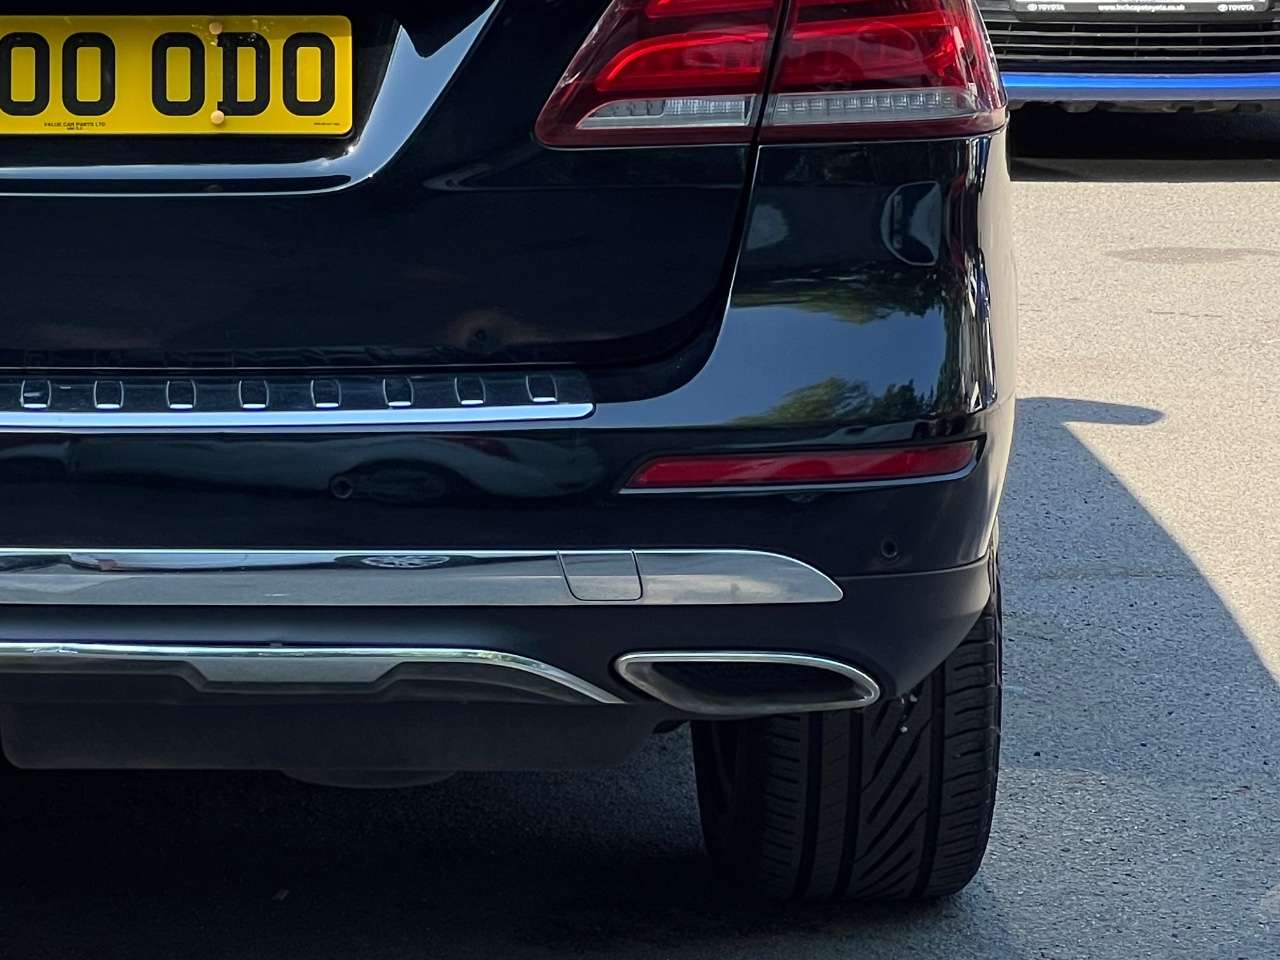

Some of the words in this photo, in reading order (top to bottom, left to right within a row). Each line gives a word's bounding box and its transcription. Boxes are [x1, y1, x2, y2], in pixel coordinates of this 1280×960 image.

[1038, 3, 1066, 11] TOYOTA
[1228, 4, 1255, 12] TOYOTA
[151, 32, 336, 116] ODO
